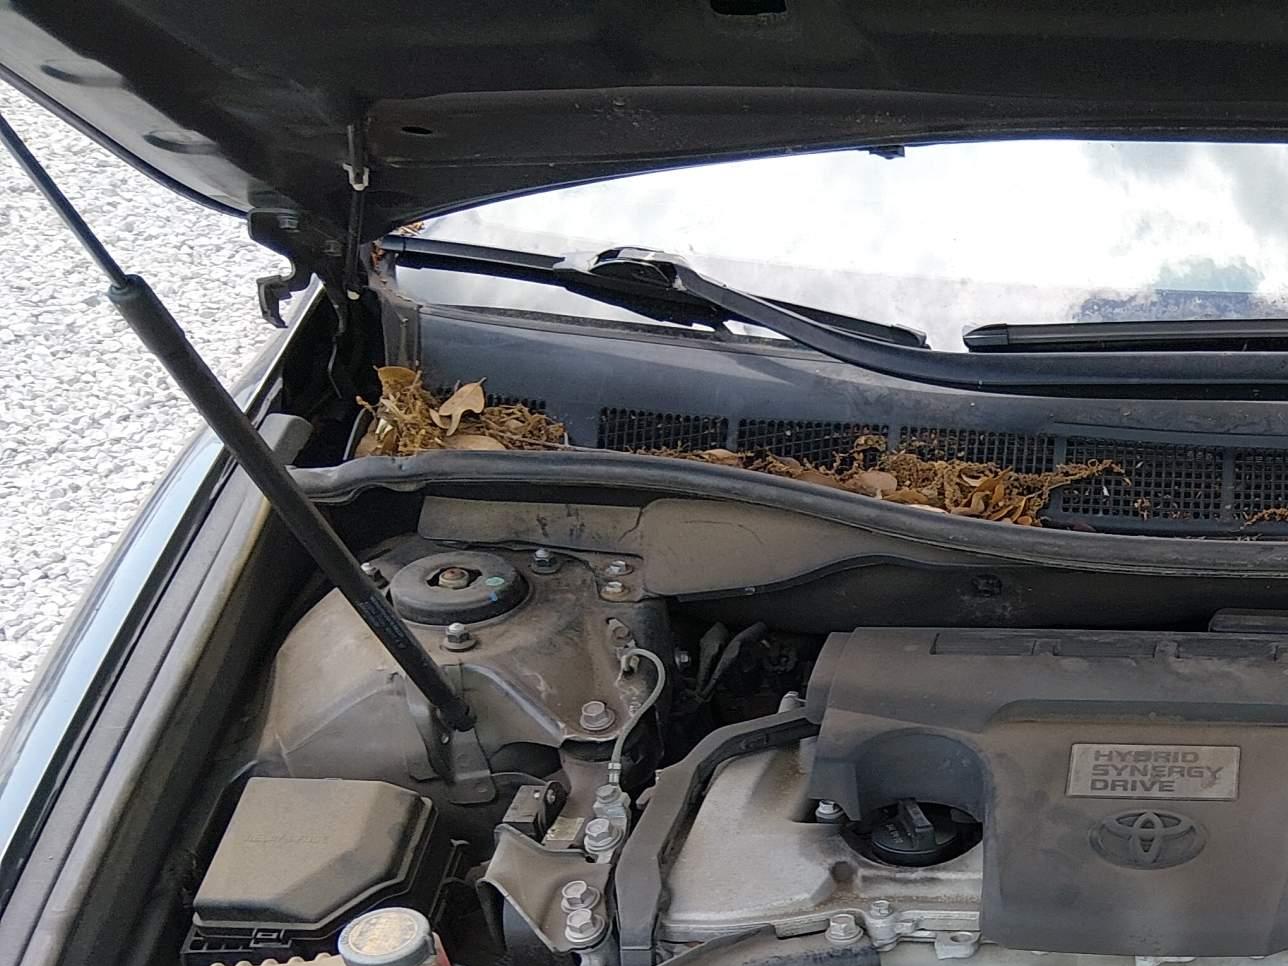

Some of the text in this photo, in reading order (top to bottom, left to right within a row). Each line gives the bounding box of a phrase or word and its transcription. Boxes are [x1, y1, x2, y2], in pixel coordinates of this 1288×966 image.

[1094, 750, 1200, 763] HYBRID
[1091, 764, 1225, 778] SYNERGY
[1090, 779, 1176, 793] DRIVE
